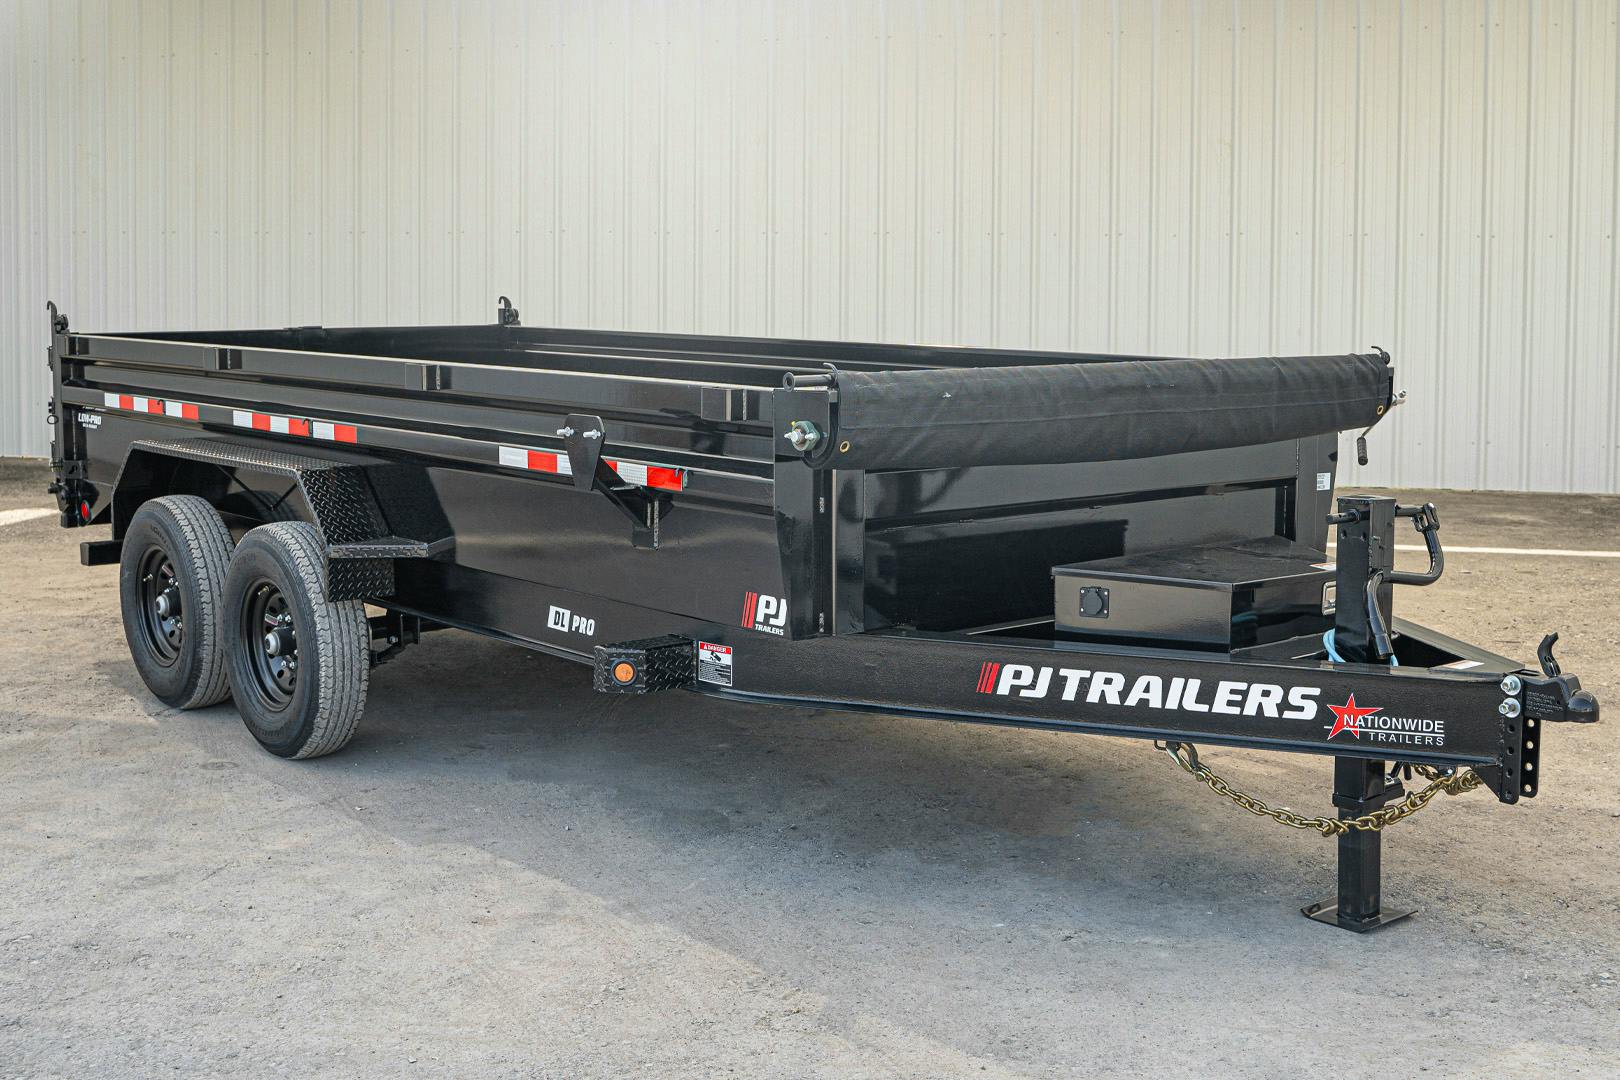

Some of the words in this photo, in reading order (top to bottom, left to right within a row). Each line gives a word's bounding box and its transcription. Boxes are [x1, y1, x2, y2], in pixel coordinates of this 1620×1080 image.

[756, 594, 787, 627] PJ
[572, 615, 595, 636] PRO
[755, 624, 784, 636] TRAILERS
[996, 664, 1053, 698] PJ
[1059, 668, 1321, 721] TRAILERS
[1344, 714, 1444, 732] NATIONWIDE
[1369, 732, 1444, 746] TRAILERS
